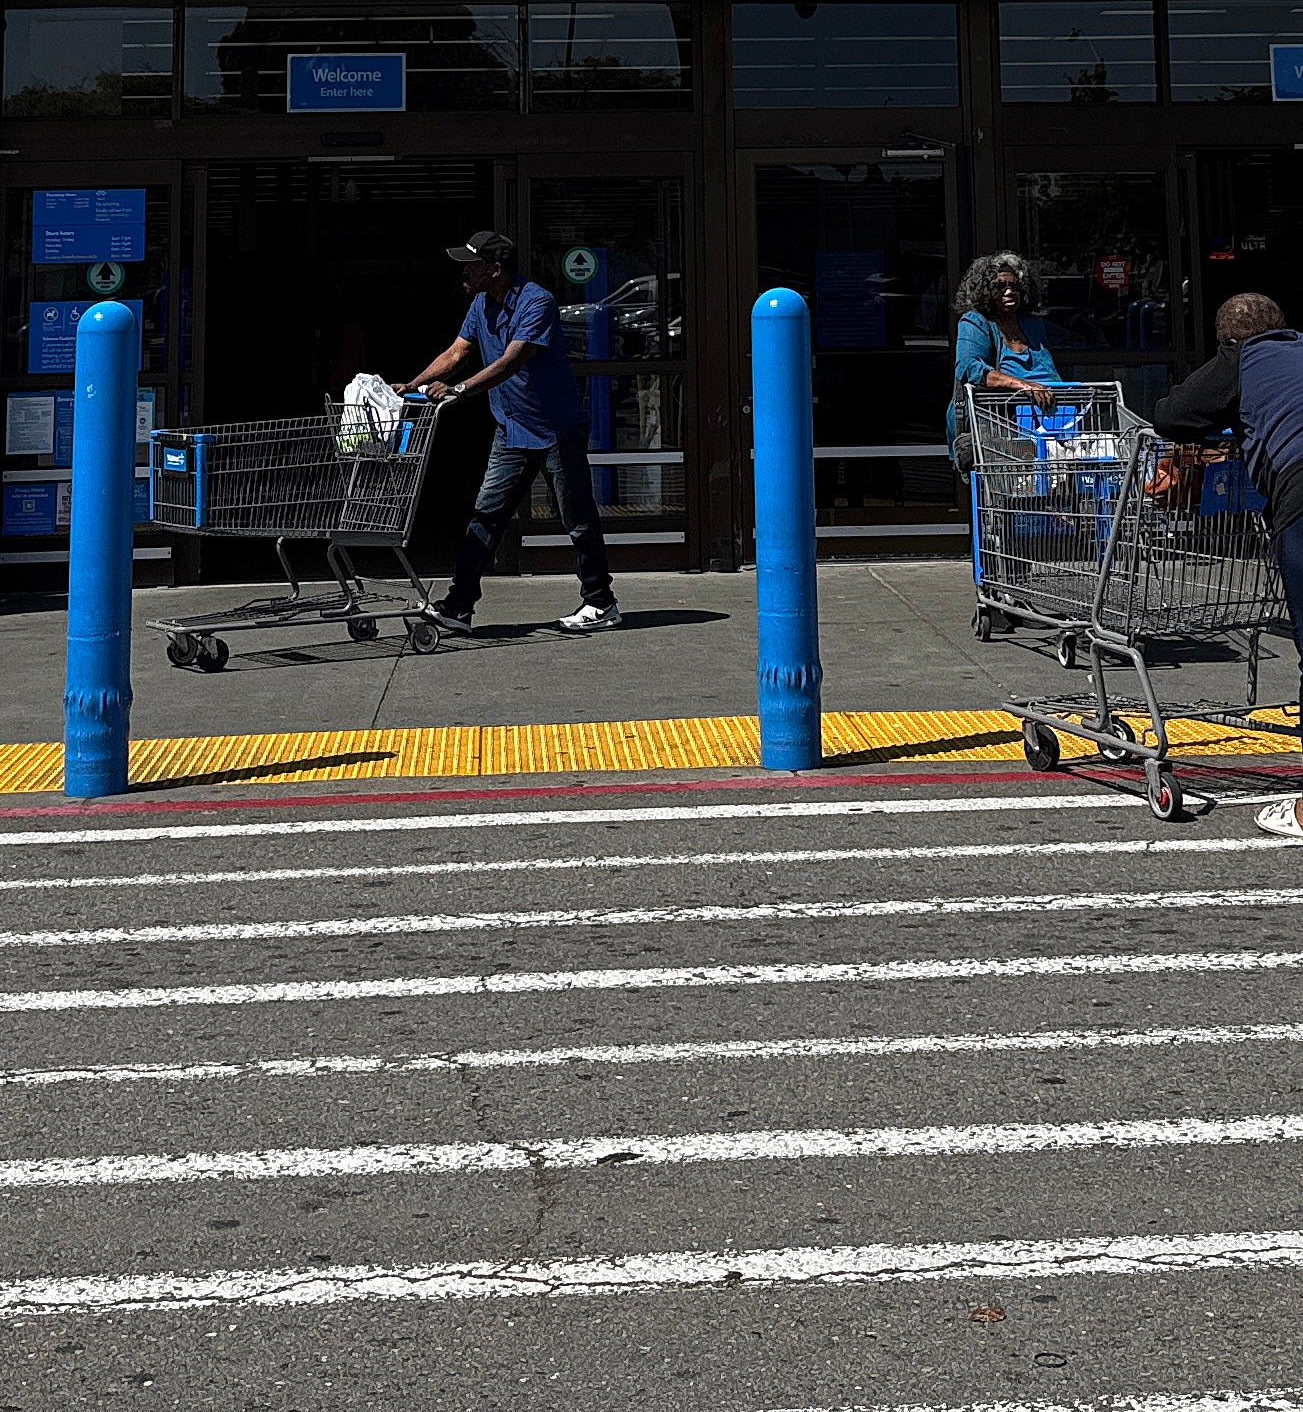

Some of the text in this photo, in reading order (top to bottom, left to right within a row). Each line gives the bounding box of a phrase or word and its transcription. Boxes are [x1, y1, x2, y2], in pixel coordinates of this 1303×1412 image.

[312, 67, 382, 82] Welcome
[320, 86, 374, 97] Enter here
